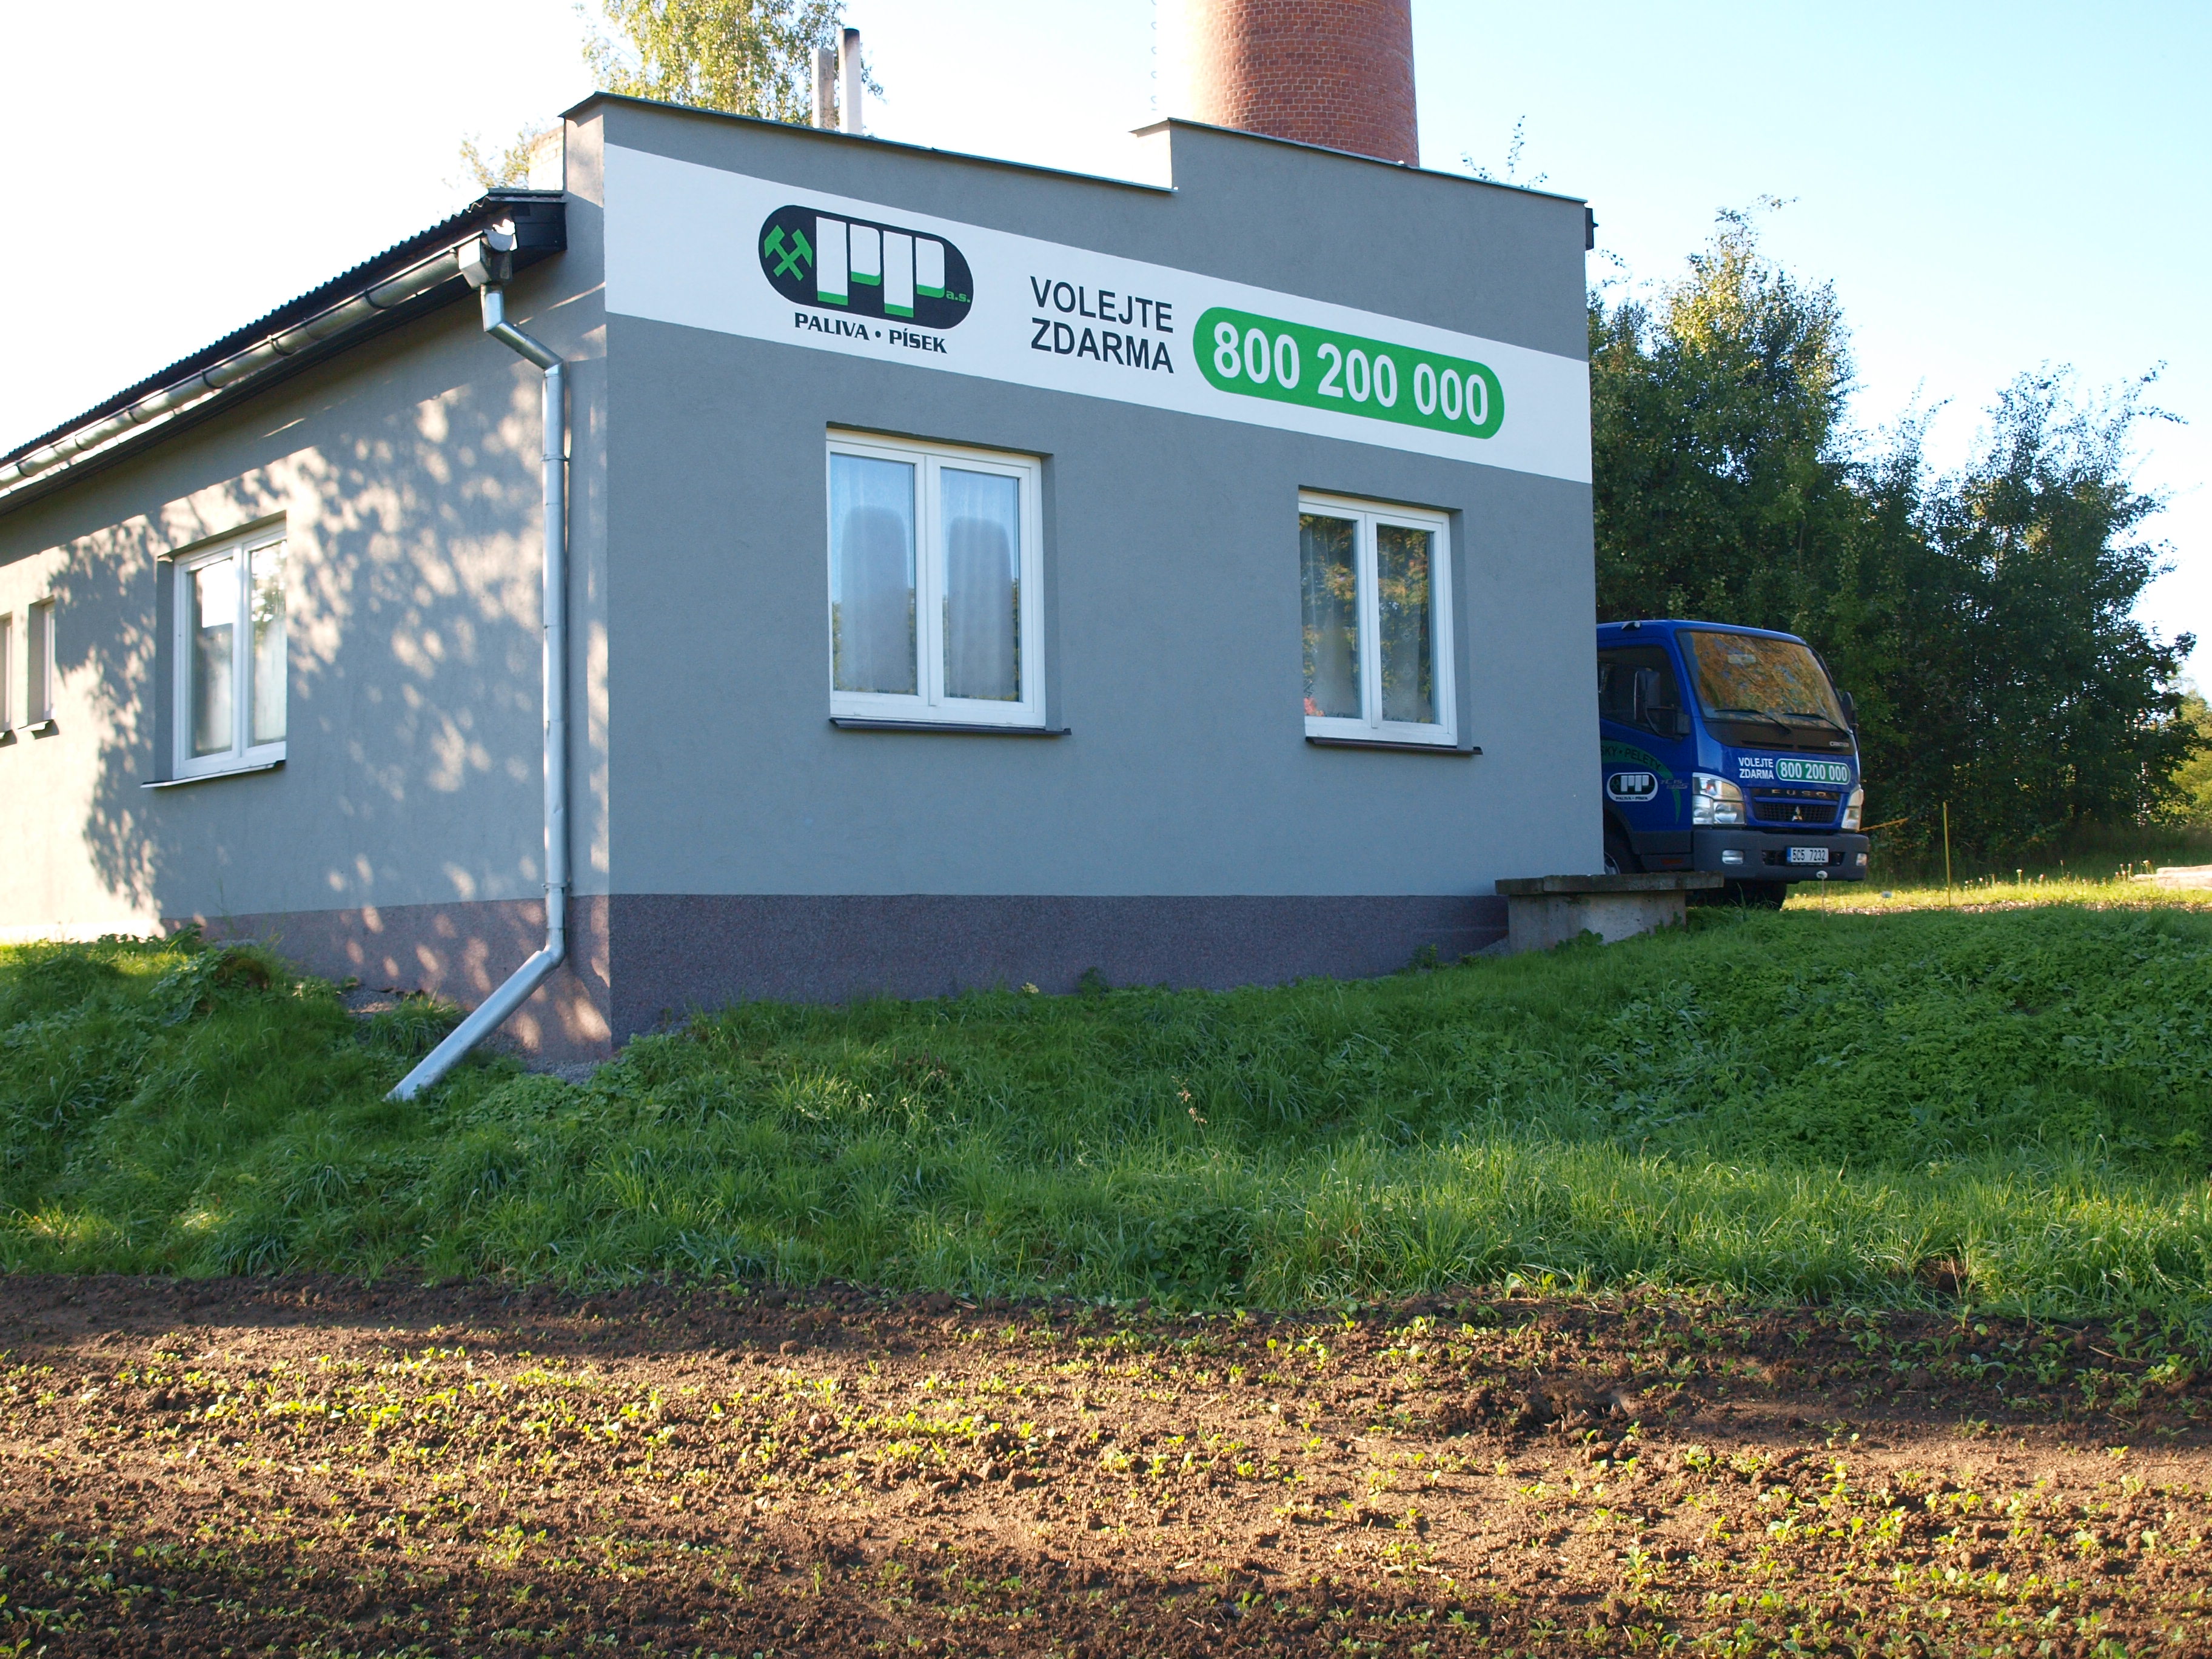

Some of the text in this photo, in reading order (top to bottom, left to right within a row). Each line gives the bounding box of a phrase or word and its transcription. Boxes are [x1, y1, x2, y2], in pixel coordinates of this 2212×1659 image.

[946, 290, 971, 303] a.s.
[1030, 276, 1173, 333] VOLEJTE
[795, 312, 947, 354] PALIVA PÍSEK
[1031, 317, 1173, 374] ZDARMA
[1214, 322, 1488, 425] 800 200 000
[1625, 748, 1661, 771] PELETY
[1738, 757, 1774, 768] VOLEJTE
[1739, 768, 1774, 779] ZDARMA
[1780, 762, 1848, 782] 800 200 000
[1793, 850, 1825, 860] 5C5 7232
